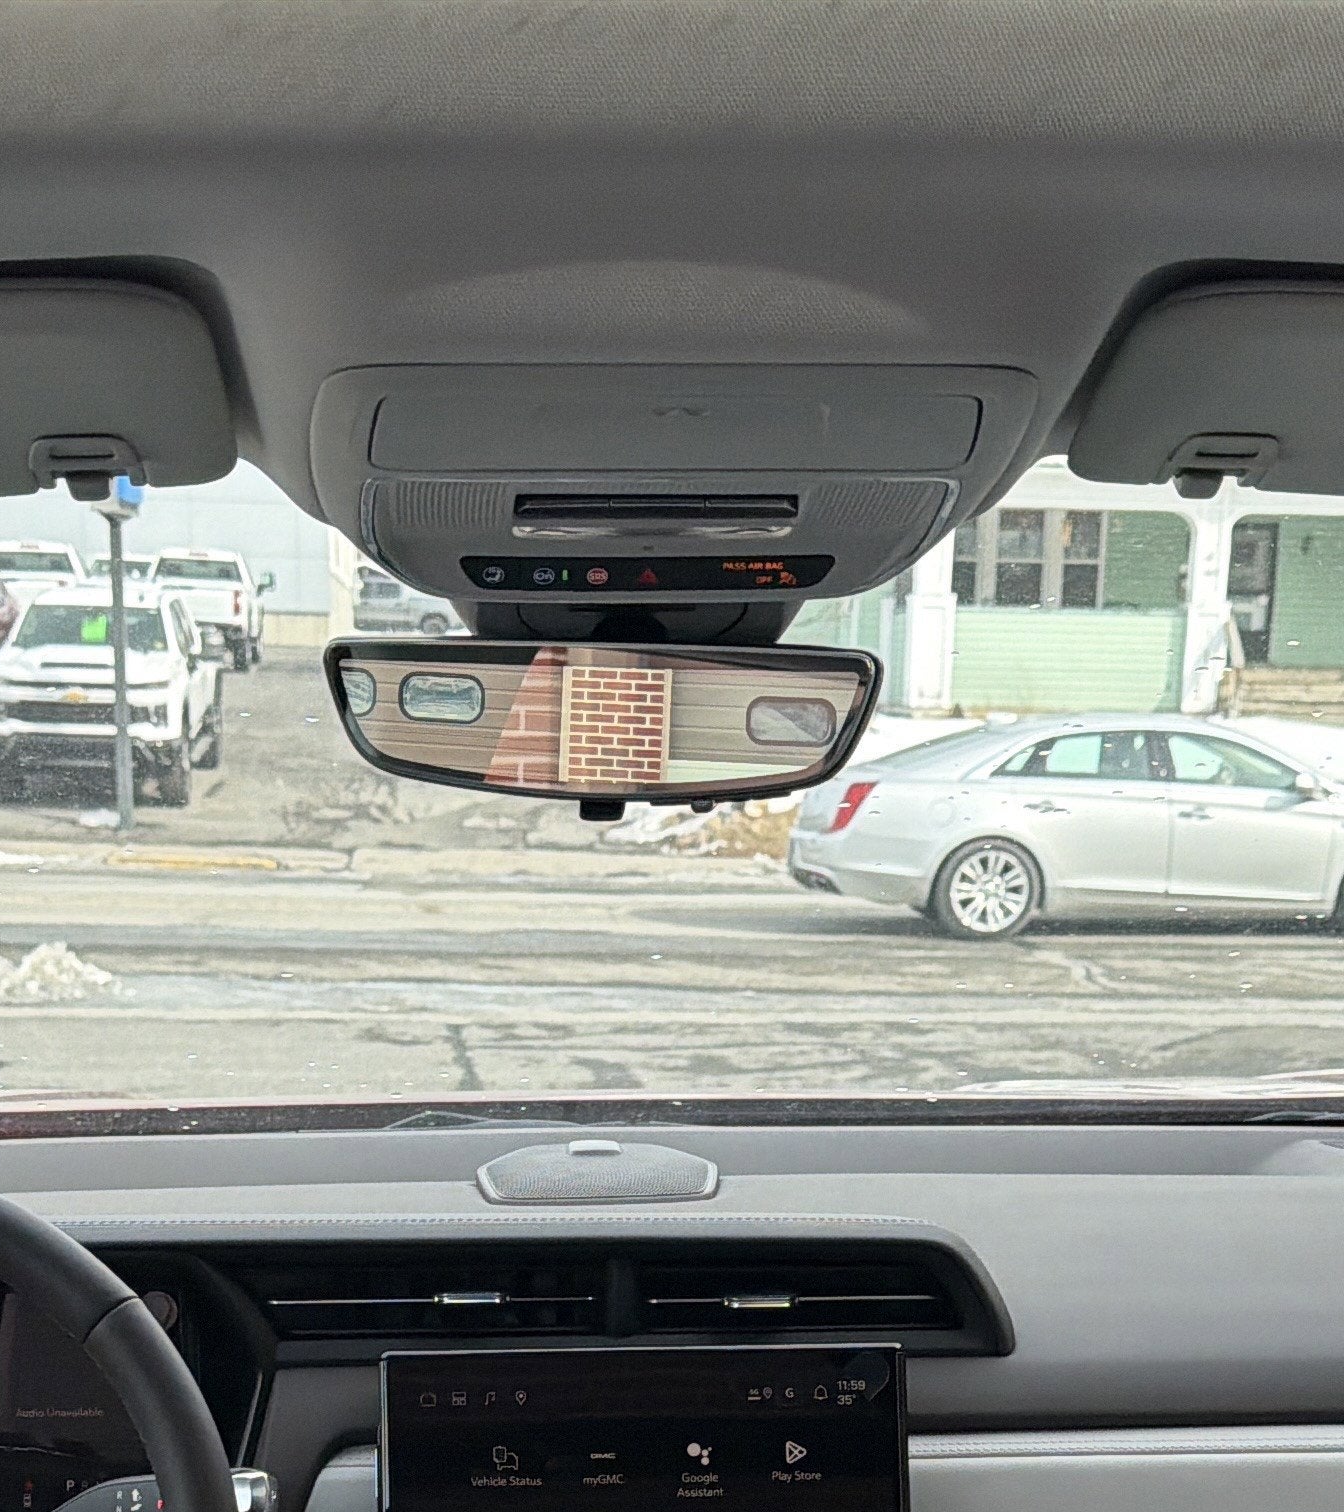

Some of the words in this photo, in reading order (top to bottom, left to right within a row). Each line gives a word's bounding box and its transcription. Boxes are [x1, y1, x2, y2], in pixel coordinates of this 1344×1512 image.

[722, 562, 747, 571] PASS
[748, 562, 763, 570] AIR
[765, 561, 784, 570] BAG
[588, 572, 607, 581] SOS
[755, 575, 773, 584] OFF
[836, 1380, 867, 1392] 11:59
[470, 1475, 508, 1487] Vehicle
[509, 1475, 543, 1487] Status
[582, 1474, 625, 1488] myGMC
[681, 1472, 719, 1486] Google
[771, 1470, 792, 1484] Play
[795, 1470, 823, 1481] Store
[676, 1486, 724, 1498] Assistant
